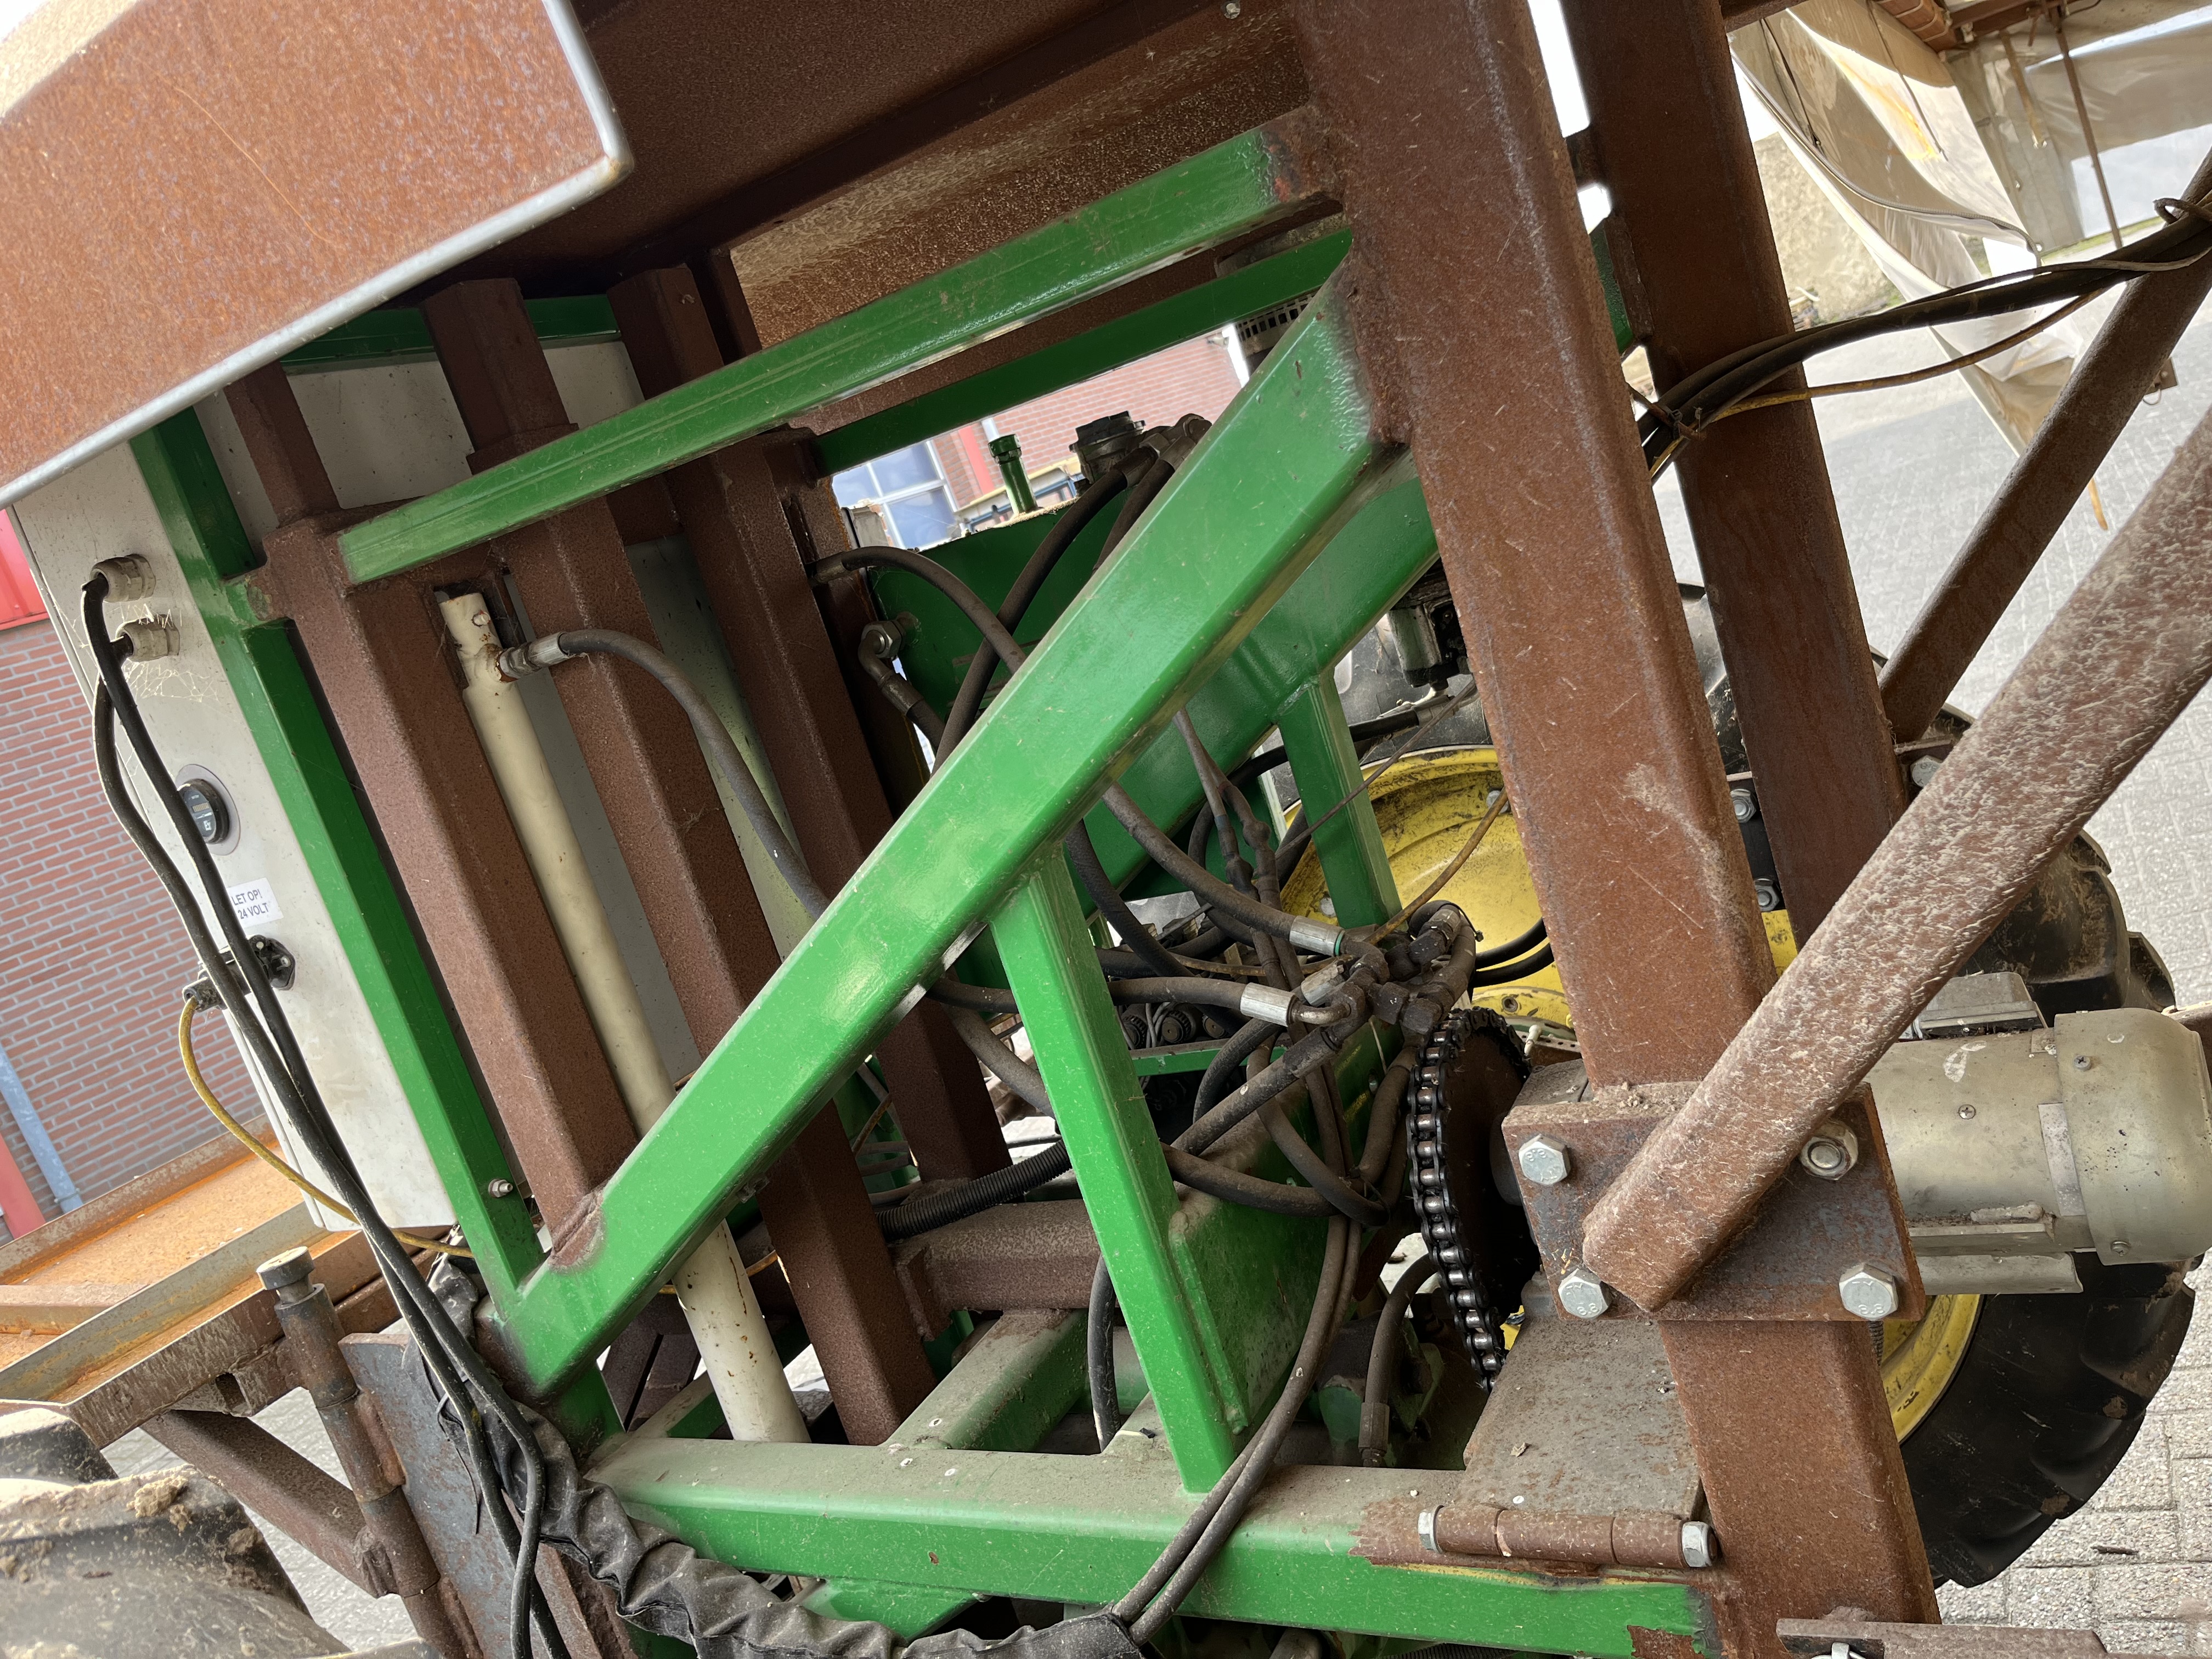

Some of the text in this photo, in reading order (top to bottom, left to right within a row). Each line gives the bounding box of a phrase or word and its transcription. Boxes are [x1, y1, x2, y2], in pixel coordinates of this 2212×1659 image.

[231, 889, 262, 905] LET OP!
[238, 902, 269, 919] 24 VOLT
[1577, 1302, 1599, 1316] 8.8
[1858, 1304, 1884, 1314] 8.8
